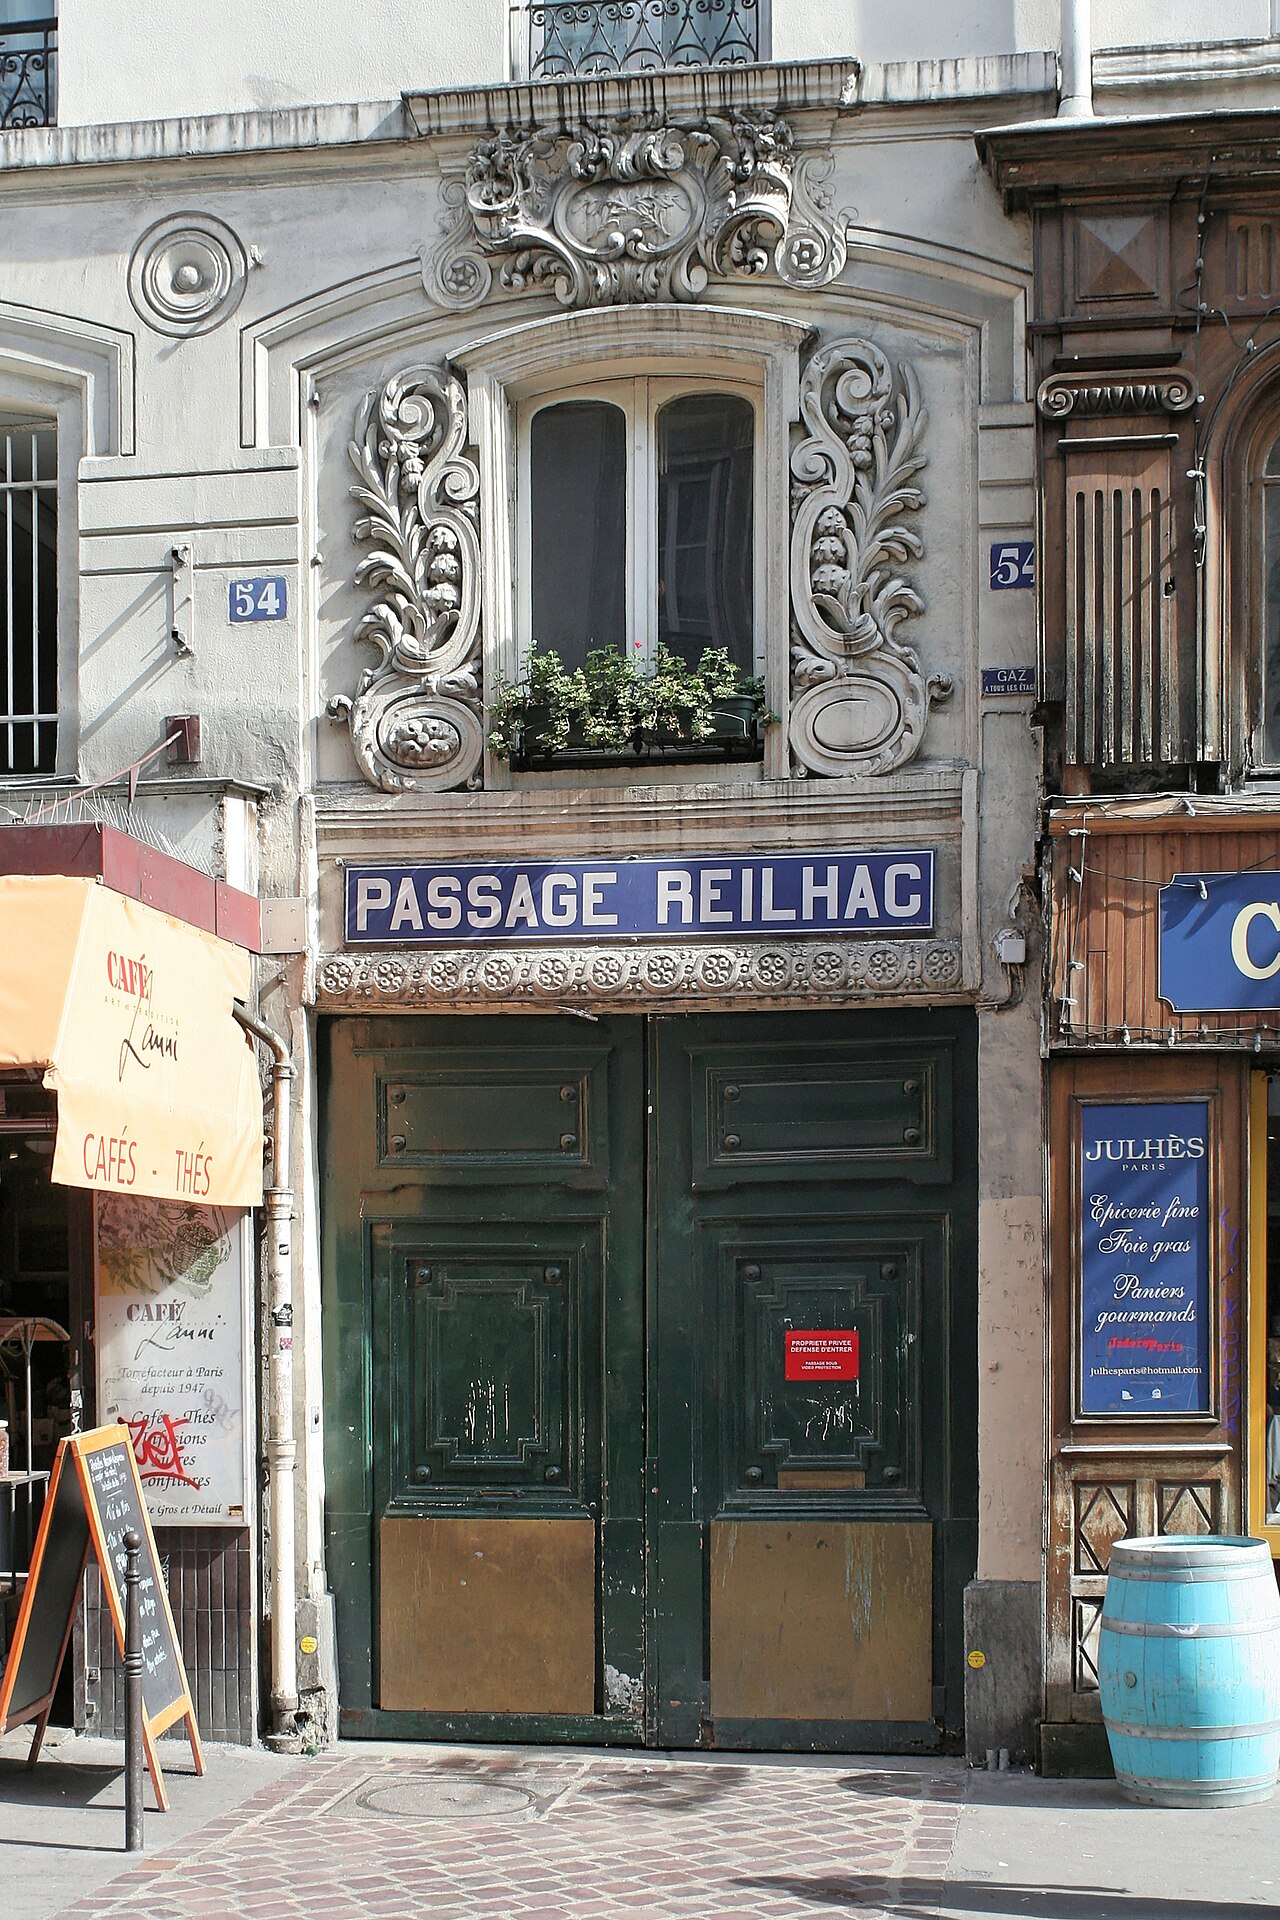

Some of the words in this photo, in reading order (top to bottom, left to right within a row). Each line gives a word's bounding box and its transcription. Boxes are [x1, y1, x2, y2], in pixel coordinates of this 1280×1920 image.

[236, 582, 279, 616] 54
[997, 670, 1027, 681] GAZ
[357, 872, 618, 931] PASSAGE
[657, 863, 922, 925] REILHAC
[1231, 902, 1280, 980] C
[107, 951, 150, 1000] CAFÉ
[1086, 1133, 1205, 1161] JULHÈS
[83, 1125, 138, 1186] CAFÉS
[175, 1141, 213, 1197] THÉS
[1122, 1163, 1166, 1171] PARIS
[1089, 1194, 1161, 1228] Epicerie
[1161, 1196, 1200, 1228] fine
[1098, 1228, 1148, 1254] Foie
[1150, 1240, 1191, 1262] gras
[1113, 1273, 1185, 1299] Paniers
[126, 1299, 181, 1321] CAFÉ
[1094, 1300, 1196, 1333] gourmands
[196, 1367, 224, 1378] Paris
[1089, 1366, 1202, 1377] julhesparis@hotmail.com
[141, 1383, 176, 1397] depuis
[179, 1383, 205, 1394] 1947
[183, 1409, 216, 1424] Thés
[158, 1505, 178, 1516] Gros
[181, 1506, 189, 1514] et
[192, 1503, 223, 1514] Détail
